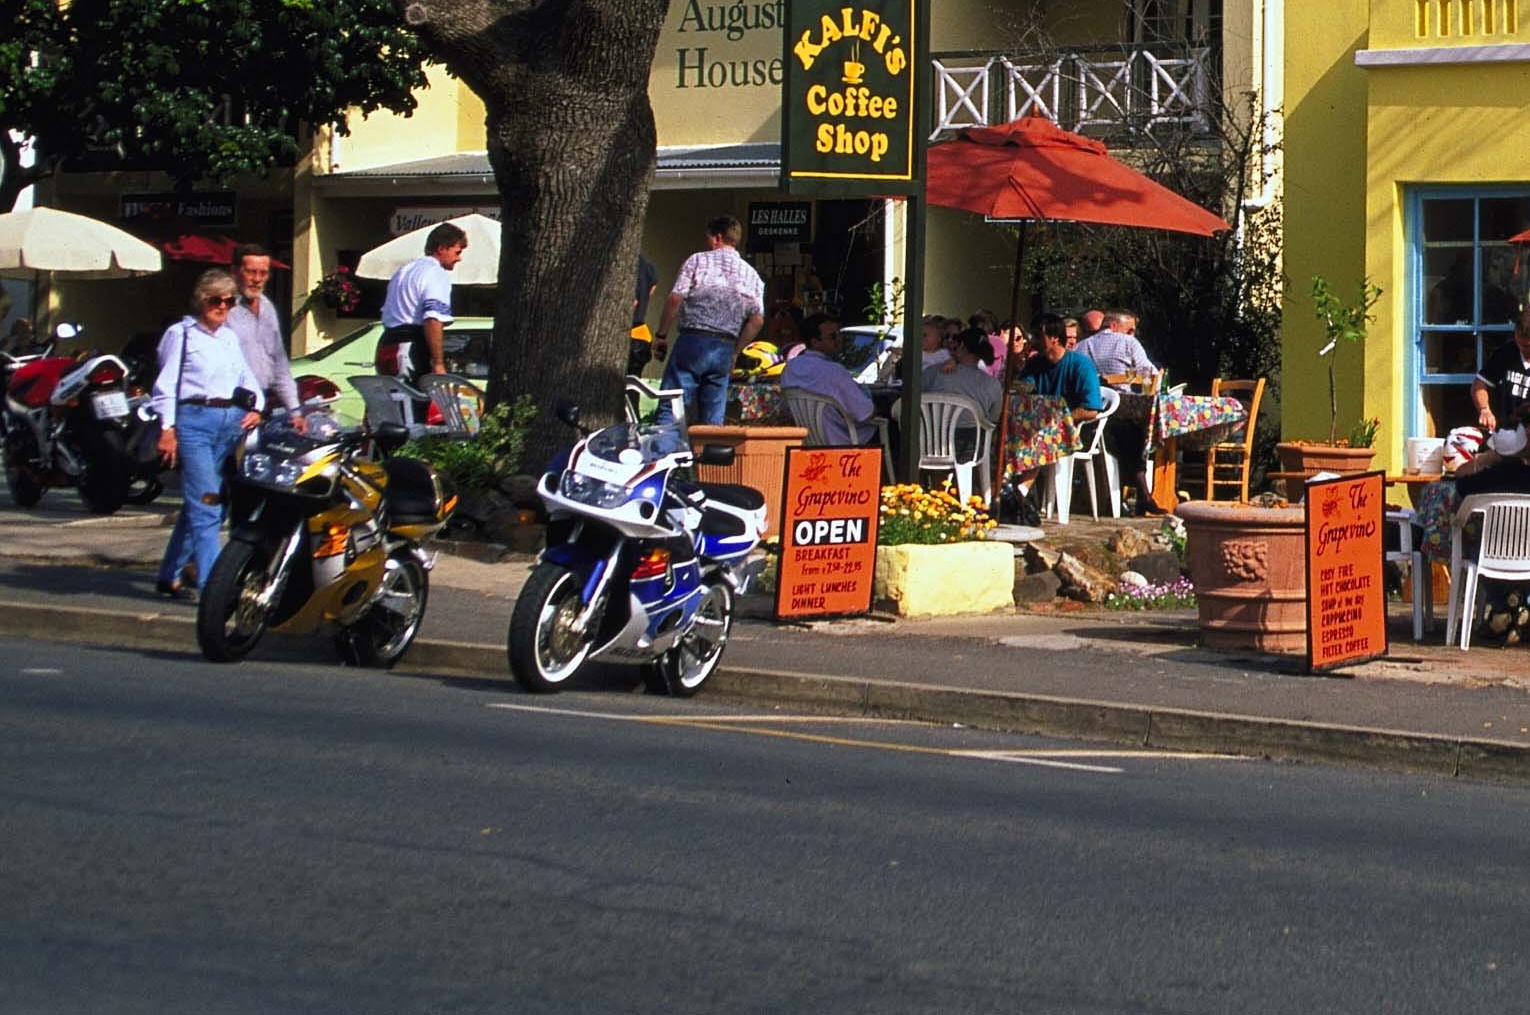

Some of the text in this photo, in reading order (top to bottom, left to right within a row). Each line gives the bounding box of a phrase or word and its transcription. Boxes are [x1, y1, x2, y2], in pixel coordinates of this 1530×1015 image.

[793, 7, 907, 75] KALFI'S
[676, 47, 784, 89] House
[807, 85, 898, 120] Coffee
[816, 123, 889, 162] Shop
[752, 208, 807, 224] LES HALLES
[838, 452, 863, 478] The
[793, 483, 871, 517] Grapevine
[1349, 481, 1368, 509] The
[795, 519, 862, 545] OPEN
[1316, 514, 1376, 556] Grapevine
[795, 547, 851, 561] BREAKFAST
[792, 580, 857, 597] LIGHT LUNCHES
[791, 596, 825, 610] DINNER
[1345, 637, 1369, 654] COFFEE
